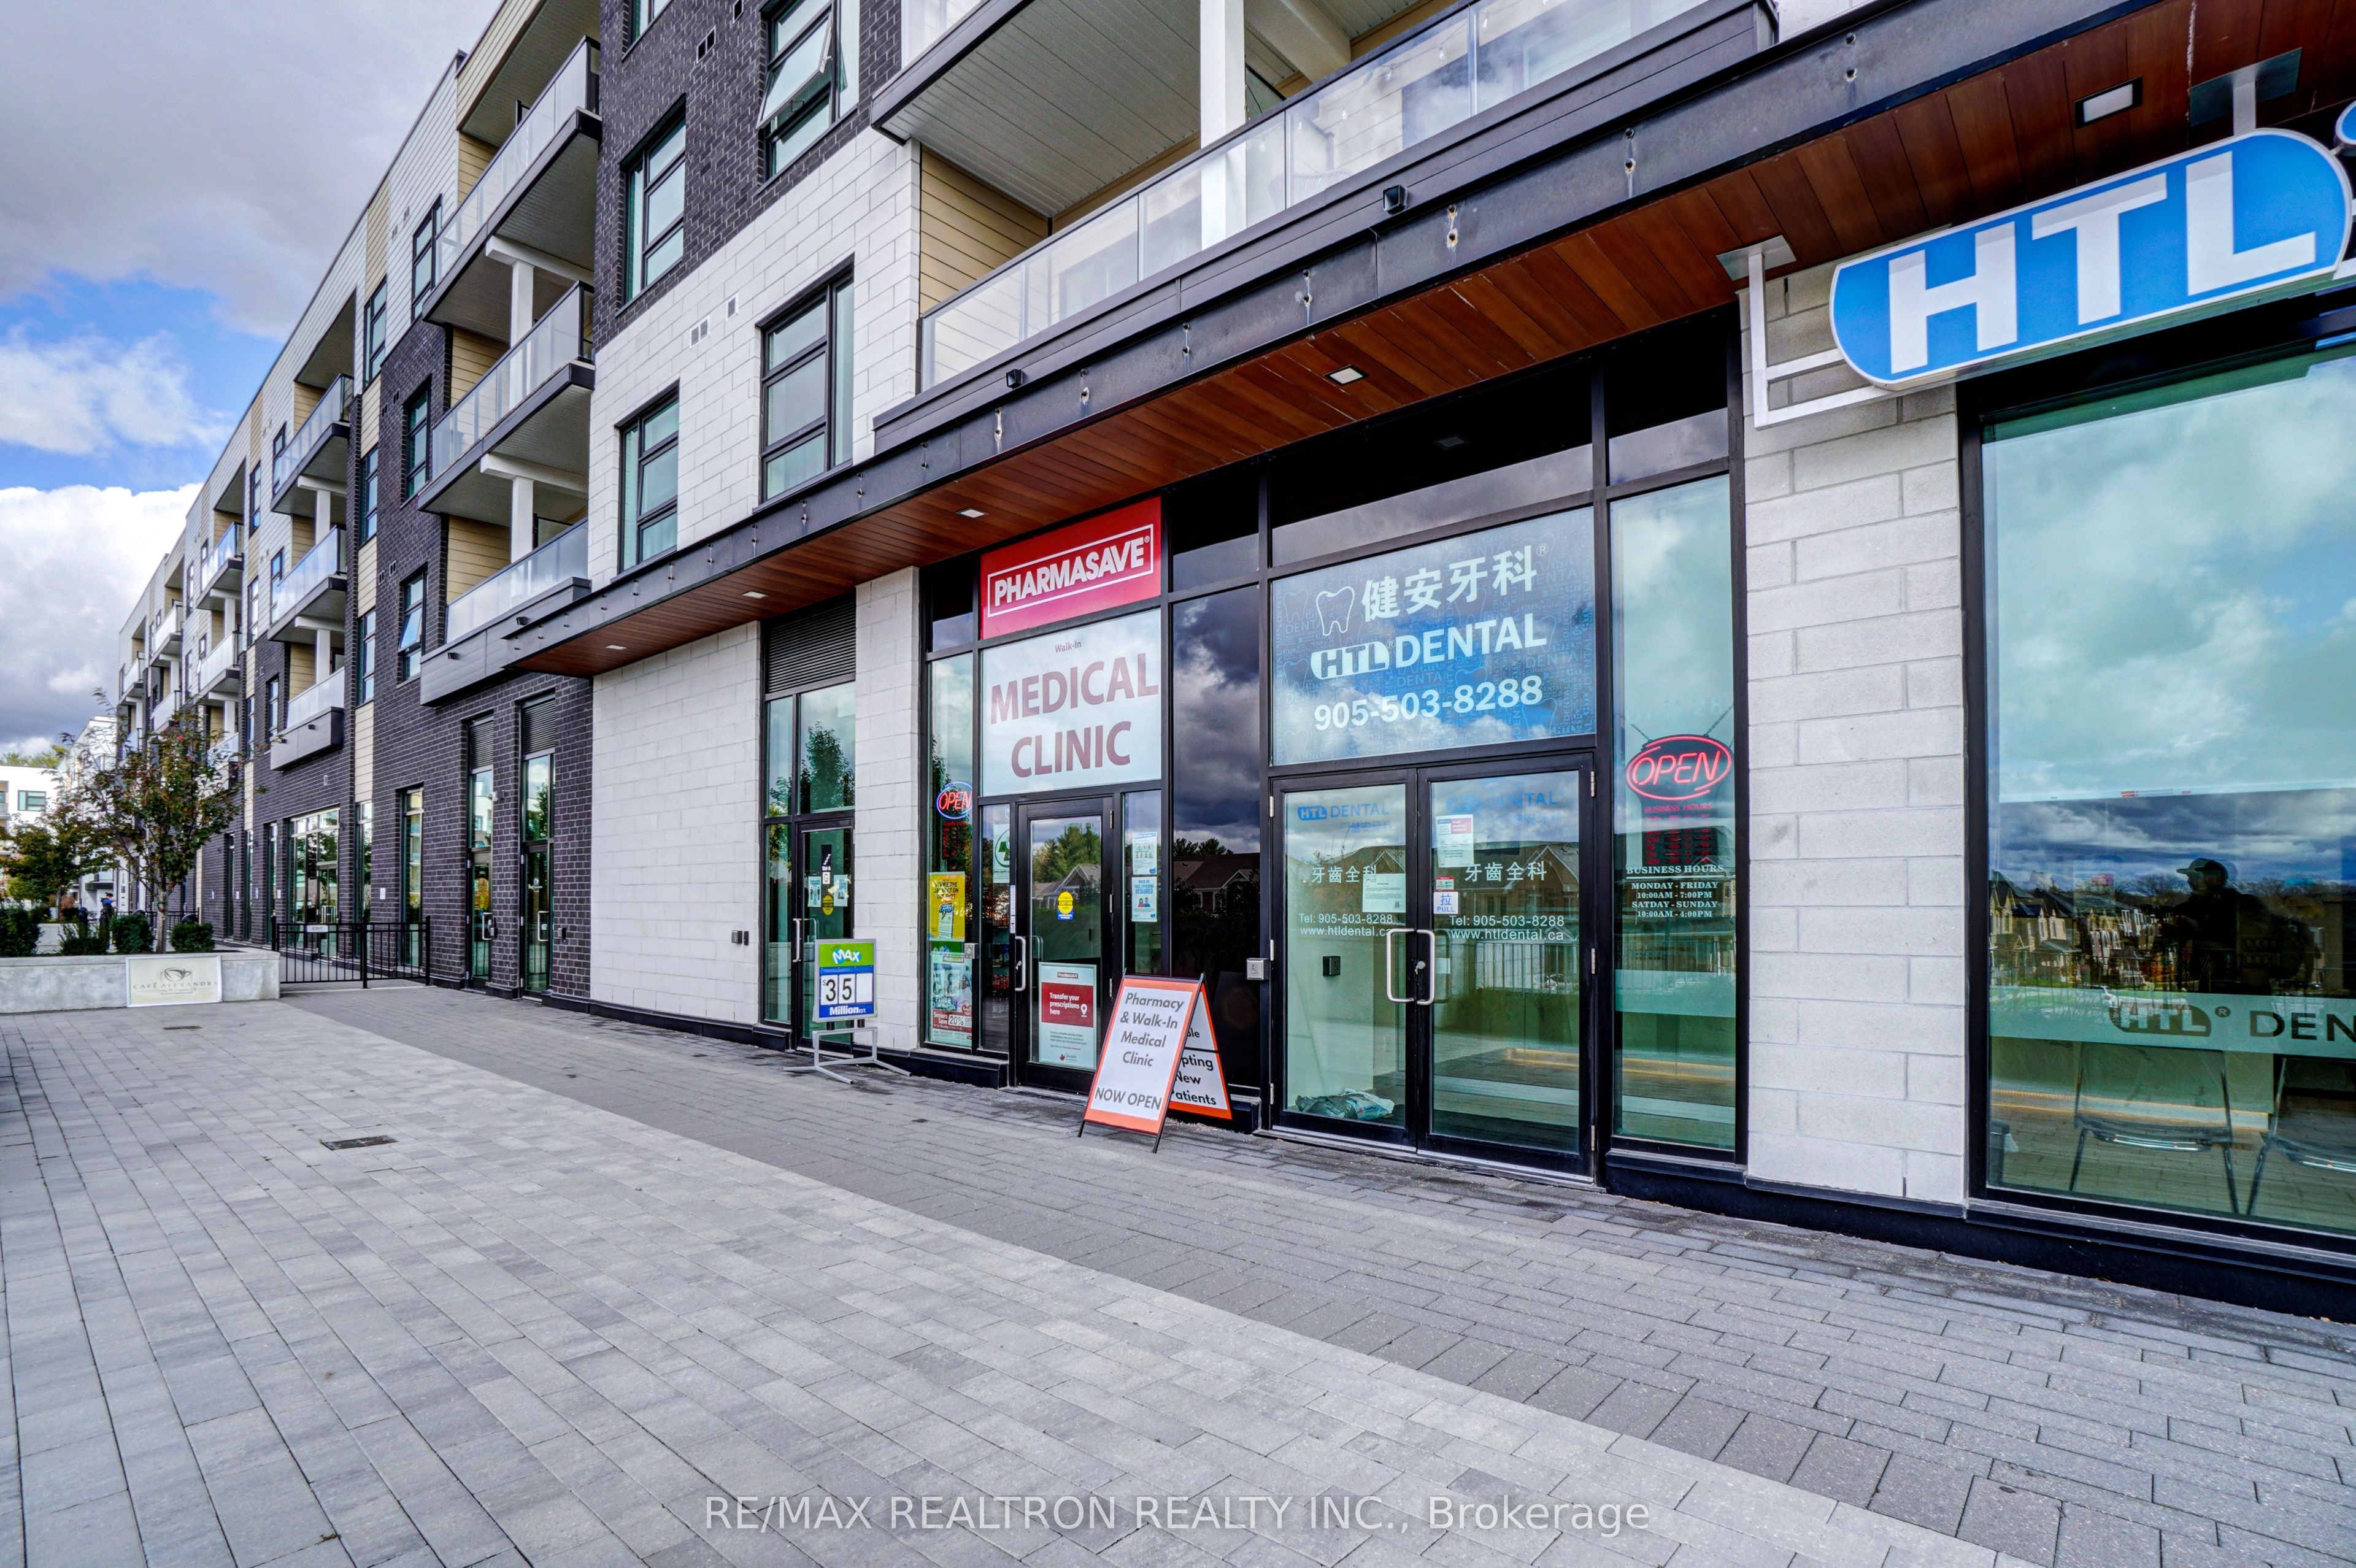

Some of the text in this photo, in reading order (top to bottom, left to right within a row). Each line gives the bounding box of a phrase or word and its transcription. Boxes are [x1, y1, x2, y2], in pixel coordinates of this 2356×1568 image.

[1888, 150, 2316, 374] HTL
[995, 536, 1144, 606] PHARMASAVE
[1361, 545, 1537, 622] 健安牙科
[1055, 640, 1082, 653] Walk-In
[1396, 613, 1546, 668] DENTAL
[990, 653, 1159, 724] MEDICAL
[1314, 675, 1543, 731] 905-503-8288
[1011, 721, 1131, 778] CLINIC
[1632, 750, 1721, 786] OPEN
[939, 791, 972, 810] OPEN
[1300, 803, 1390, 820] HTL DENTAL
[823, 874, 828, 883] G
[1464, 860, 1547, 882] 牙齒全科
[1440, 893, 1452, 906] 拉
[1299, 913, 1393, 924] Tel: 905-503-8288
[1449, 915, 1564, 926] Tel: 905-503-8288
[1451, 928, 1564, 940] www.htldental.ca
[833, 949, 860, 964] MAX
[830, 1005, 860, 1016] Million
[1050, 1001, 1080, 1010] prescriptions
[1125, 993, 1185, 1012] Pharmacy
[950, 1015, 964, 1026] 20%
[1120, 1012, 1178, 1029] & Walk-In
[2120, 1005, 2356, 1043] HTL DEN
[1121, 1031, 1167, 1048] Medical
[1123, 1051, 1153, 1067] Clinic
[1180, 1054, 1214, 1070] pting
[1095, 1087, 1162, 1110] NOW OPEN
